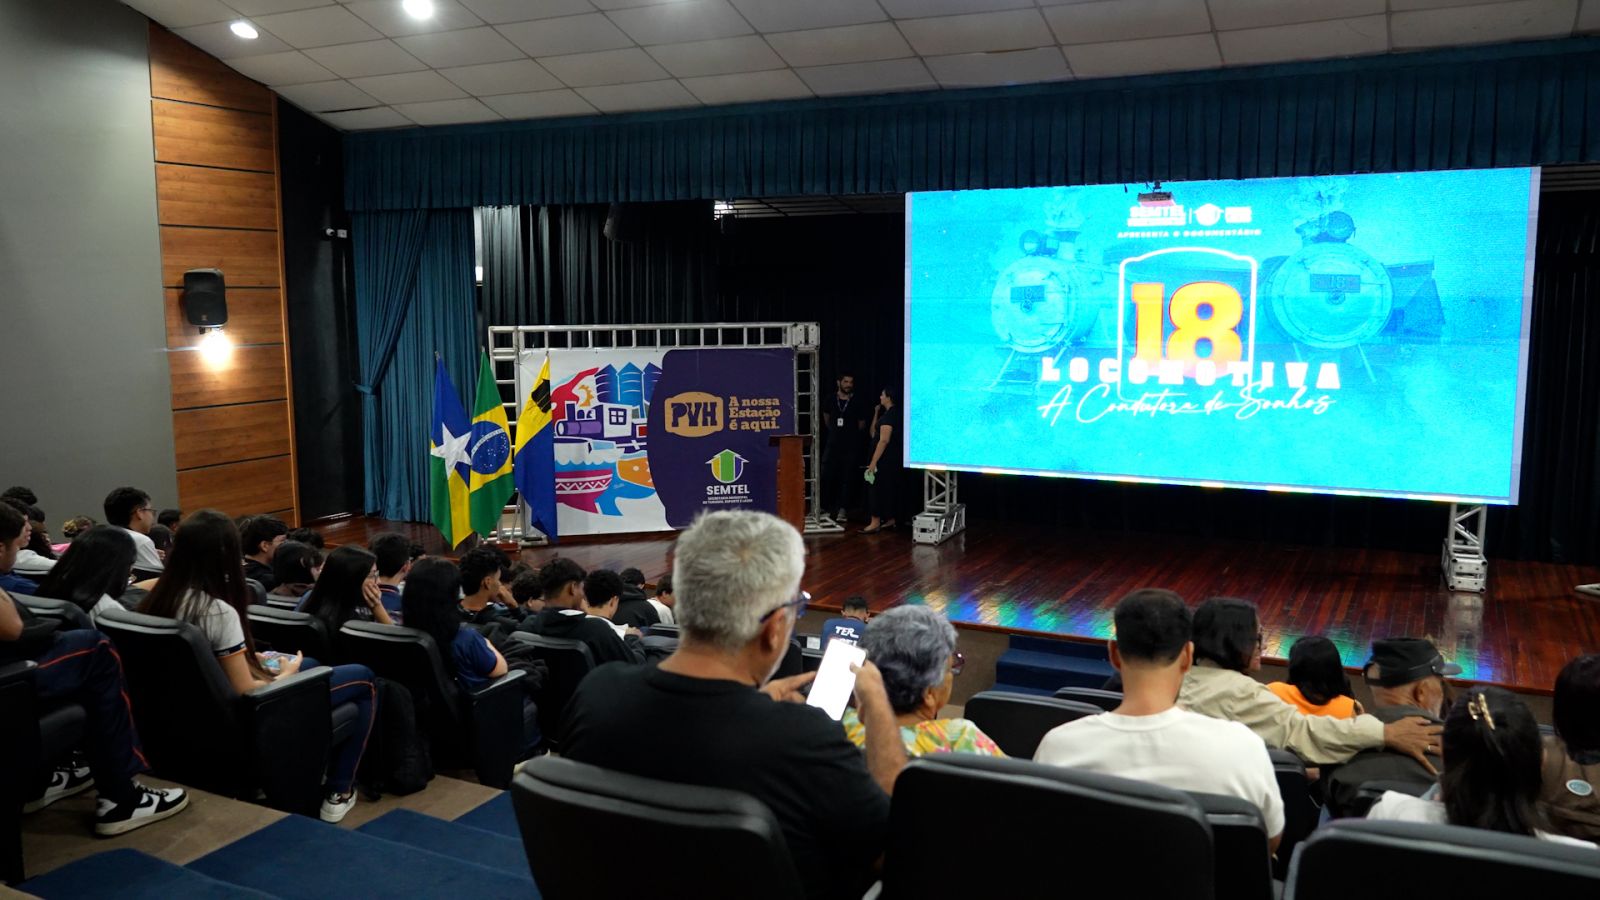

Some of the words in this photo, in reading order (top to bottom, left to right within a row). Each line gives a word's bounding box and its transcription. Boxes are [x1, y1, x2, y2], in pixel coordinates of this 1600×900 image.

[1131, 281, 1244, 378] 18
[1041, 357, 1341, 389] LOCOMOTIVA
[728, 396, 739, 407] A
[741, 397, 780, 407] nossa
[1037, 384, 1073, 427] A
[1076, 383, 1202, 424] Condutora
[1203, 390, 1227, 416] de
[1234, 380, 1337, 421] Sonhos
[671, 401, 718, 428] PVH
[728, 406, 781, 420] Estação
[729, 419, 738, 431] é
[741, 417, 780, 432] aqui.
[706, 484, 750, 496] SEMTEL
